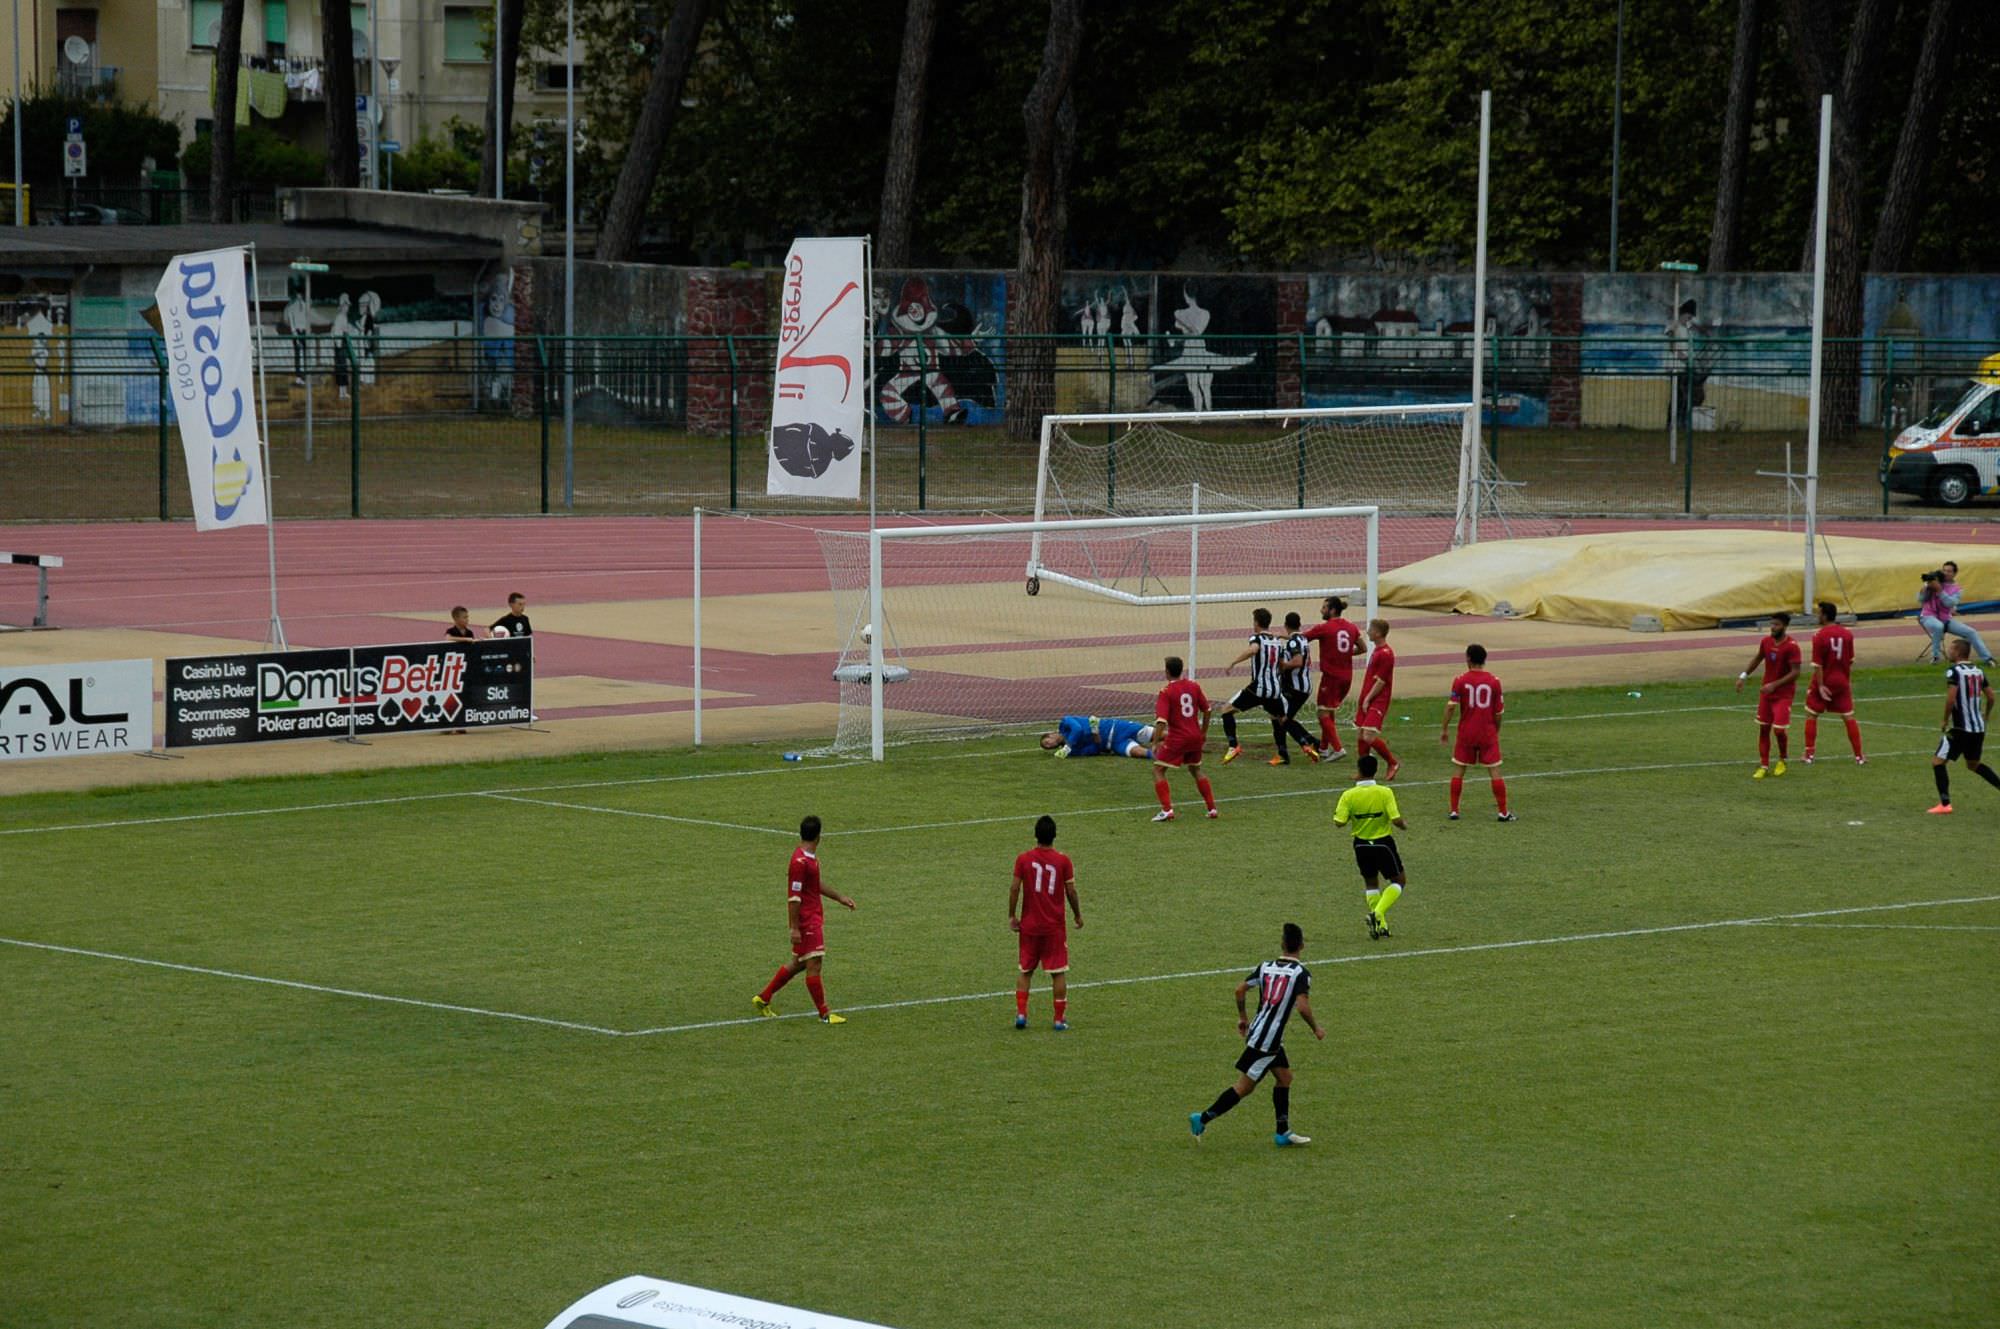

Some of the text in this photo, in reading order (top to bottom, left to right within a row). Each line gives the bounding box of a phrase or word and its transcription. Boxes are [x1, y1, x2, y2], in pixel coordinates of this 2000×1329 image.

[70, 119, 79, 132] P
[1337, 630, 1350, 652] 6
[1830, 637, 1843, 660] 4
[183, 663, 247, 680] Casinò Live
[259, 653, 467, 703] DomusBet.it
[0, 678, 128, 725] AL
[174, 684, 256, 703] People's Poker
[487, 686, 509, 700] Slot
[1464, 683, 1491, 708] 10
[178, 706, 250, 722] Scommesse
[465, 706, 529, 724] Bingo online
[1180, 693, 1193, 717] 8
[258, 710, 375, 732] Poker and Games
[191, 724, 236, 741] sportive
[1031, 862, 1057, 895] 11
[1263, 975, 1288, 1005] 10
